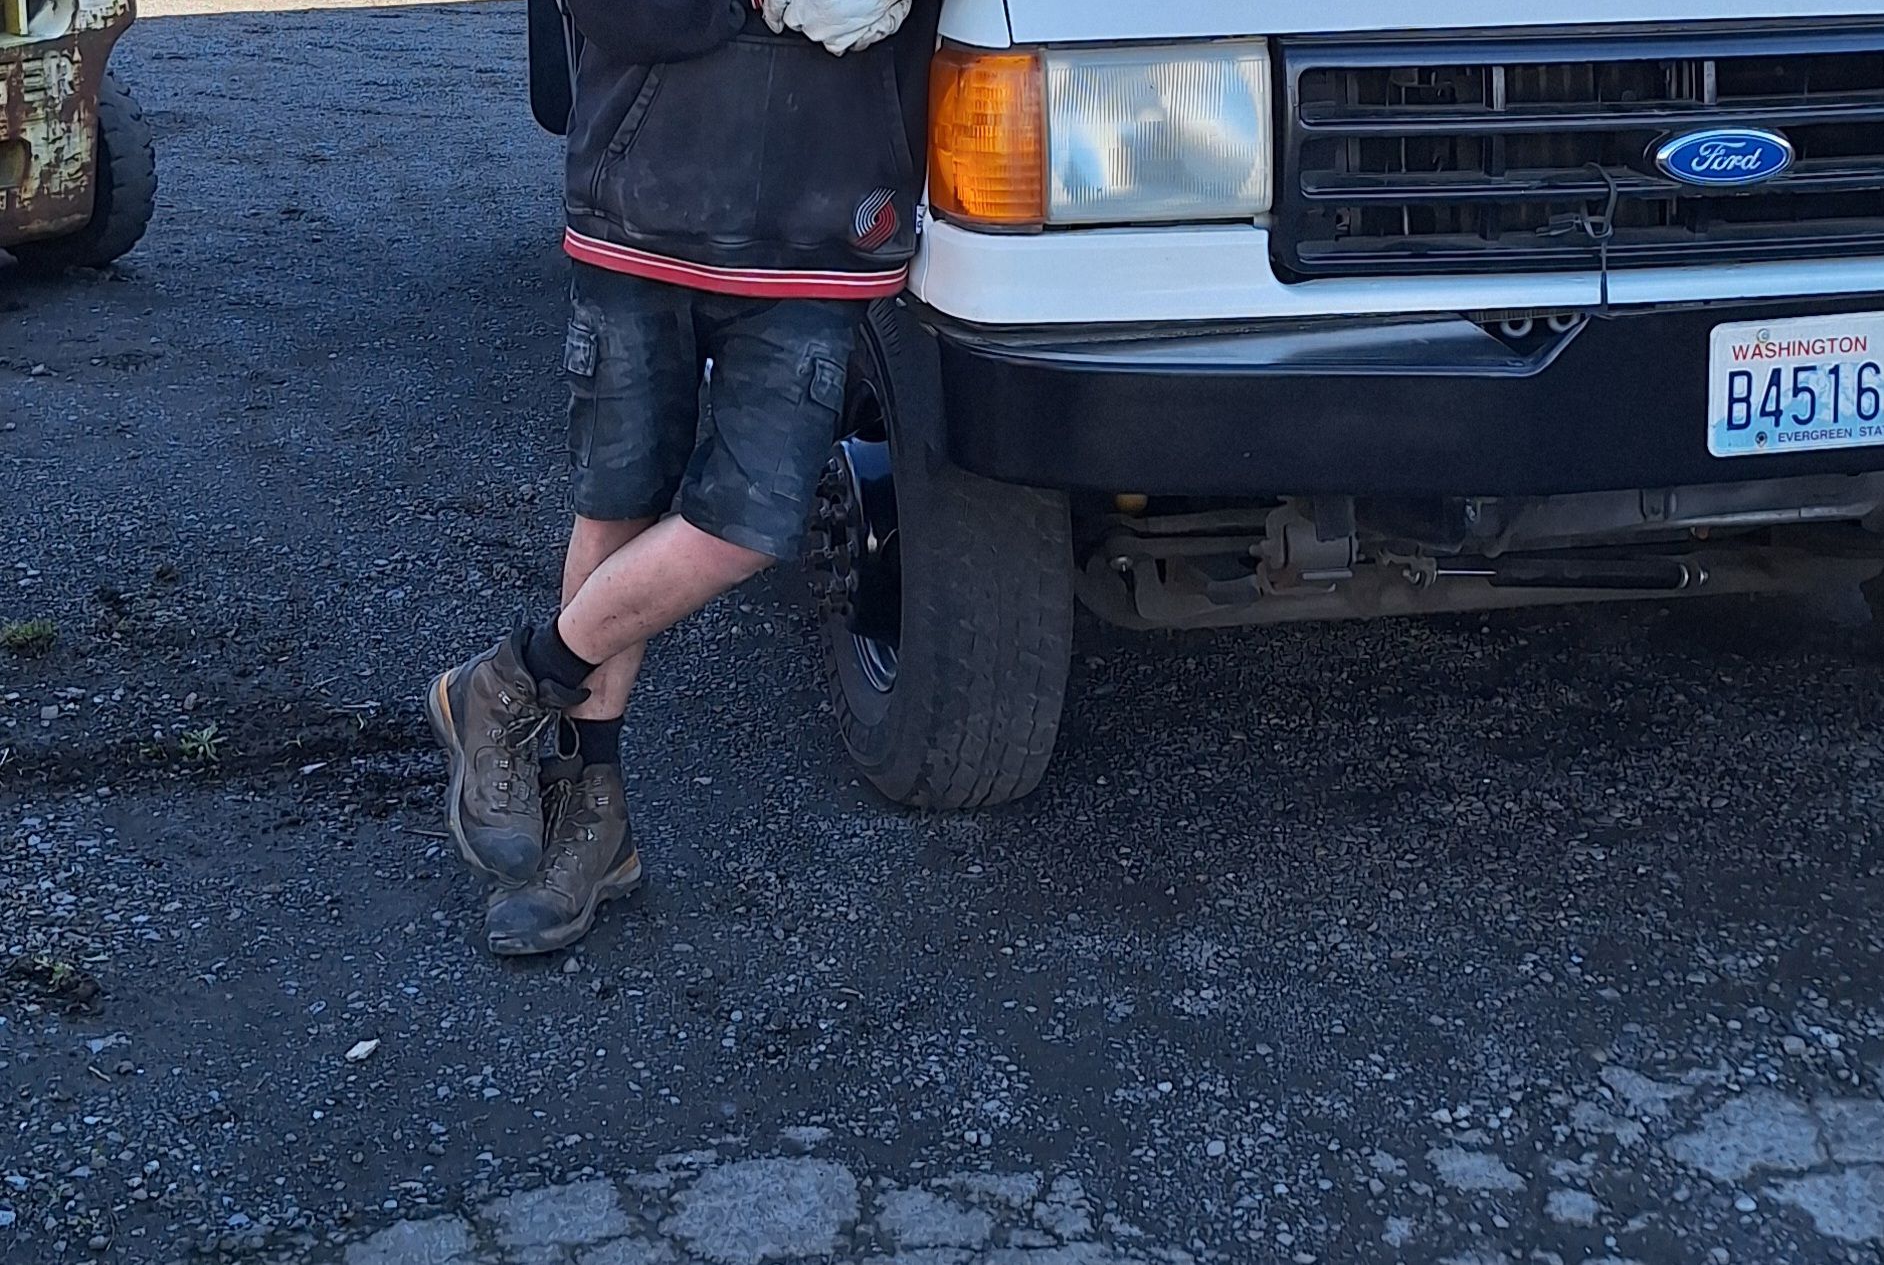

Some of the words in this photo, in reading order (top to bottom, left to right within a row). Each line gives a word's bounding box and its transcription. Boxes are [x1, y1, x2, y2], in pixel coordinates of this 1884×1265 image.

[1691, 141, 1762, 171] Ford
[1732, 336, 1867, 360] WASHINGTON
[1726, 362, 1882, 431] B4516
[1777, 428, 1853, 443] EVERGREEN
